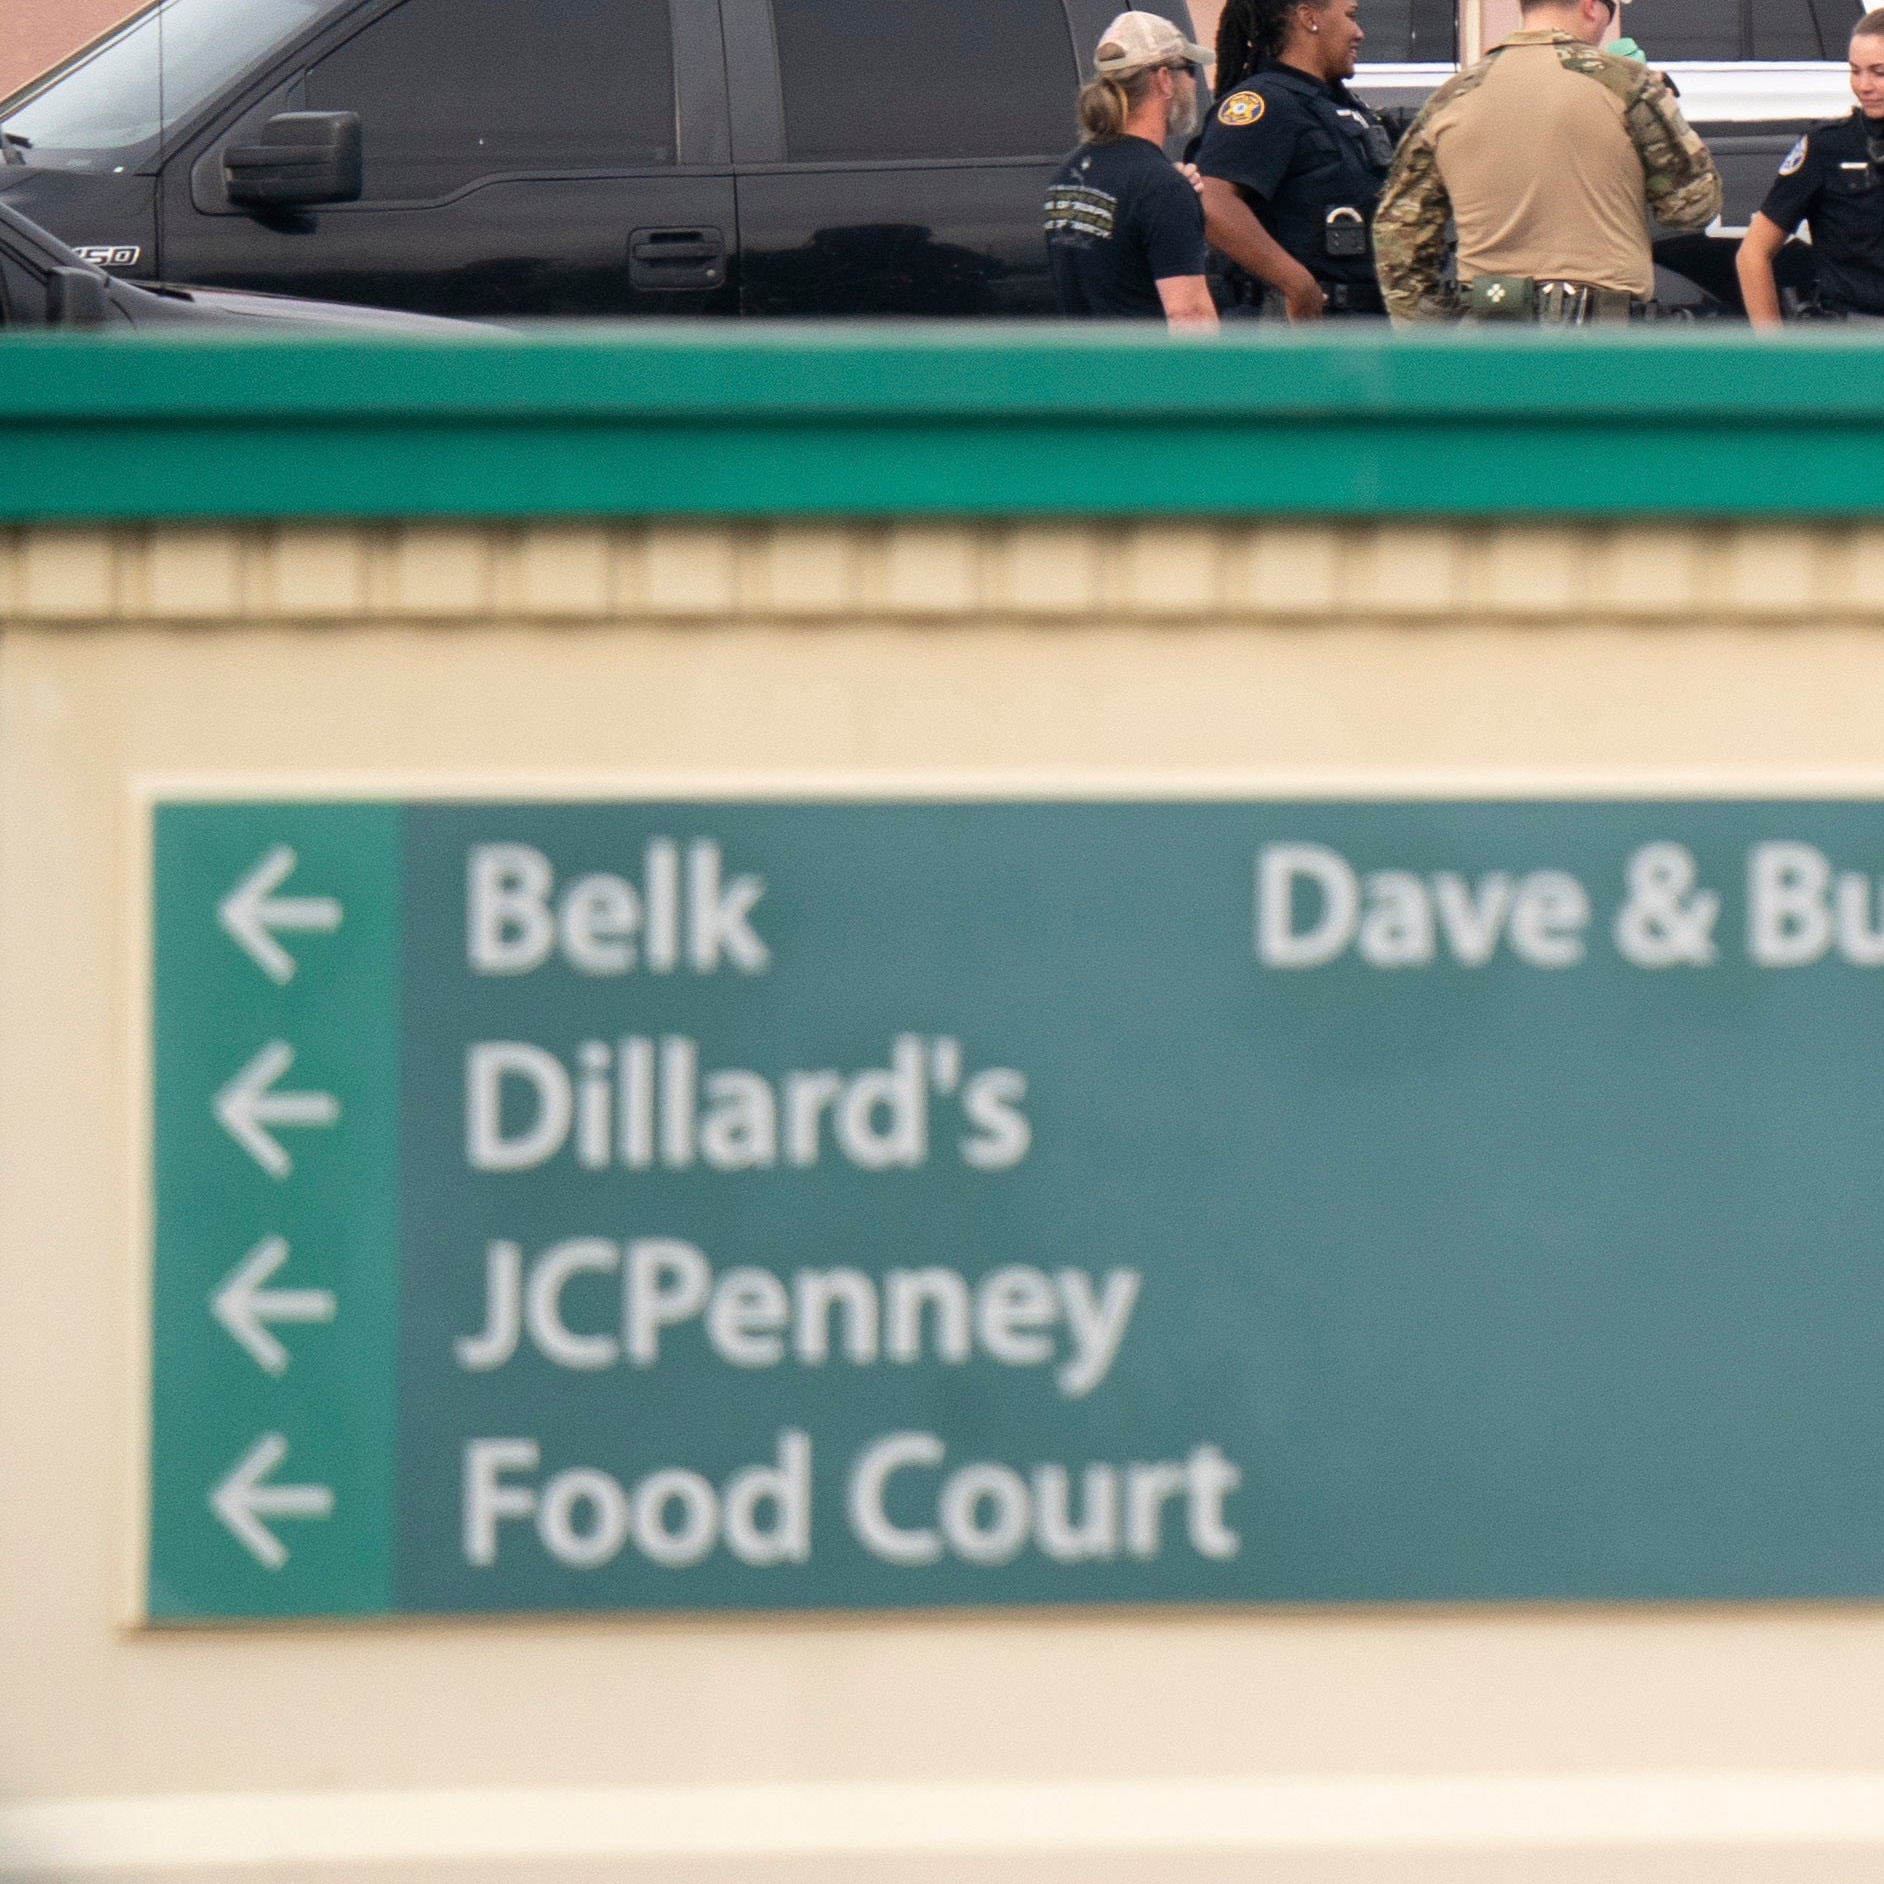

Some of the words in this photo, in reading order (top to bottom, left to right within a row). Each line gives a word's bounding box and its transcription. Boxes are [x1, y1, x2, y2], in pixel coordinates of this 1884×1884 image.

[462, 838, 770, 976] Belk
[1256, 839, 1592, 970] Dave
[1613, 839, 1721, 969] &
[463, 1033, 1033, 1173] Dillard's
[456, 1236, 1142, 1399] JCPenney
[460, 1431, 813, 1570] Food
[847, 1431, 1241, 1568] Court
